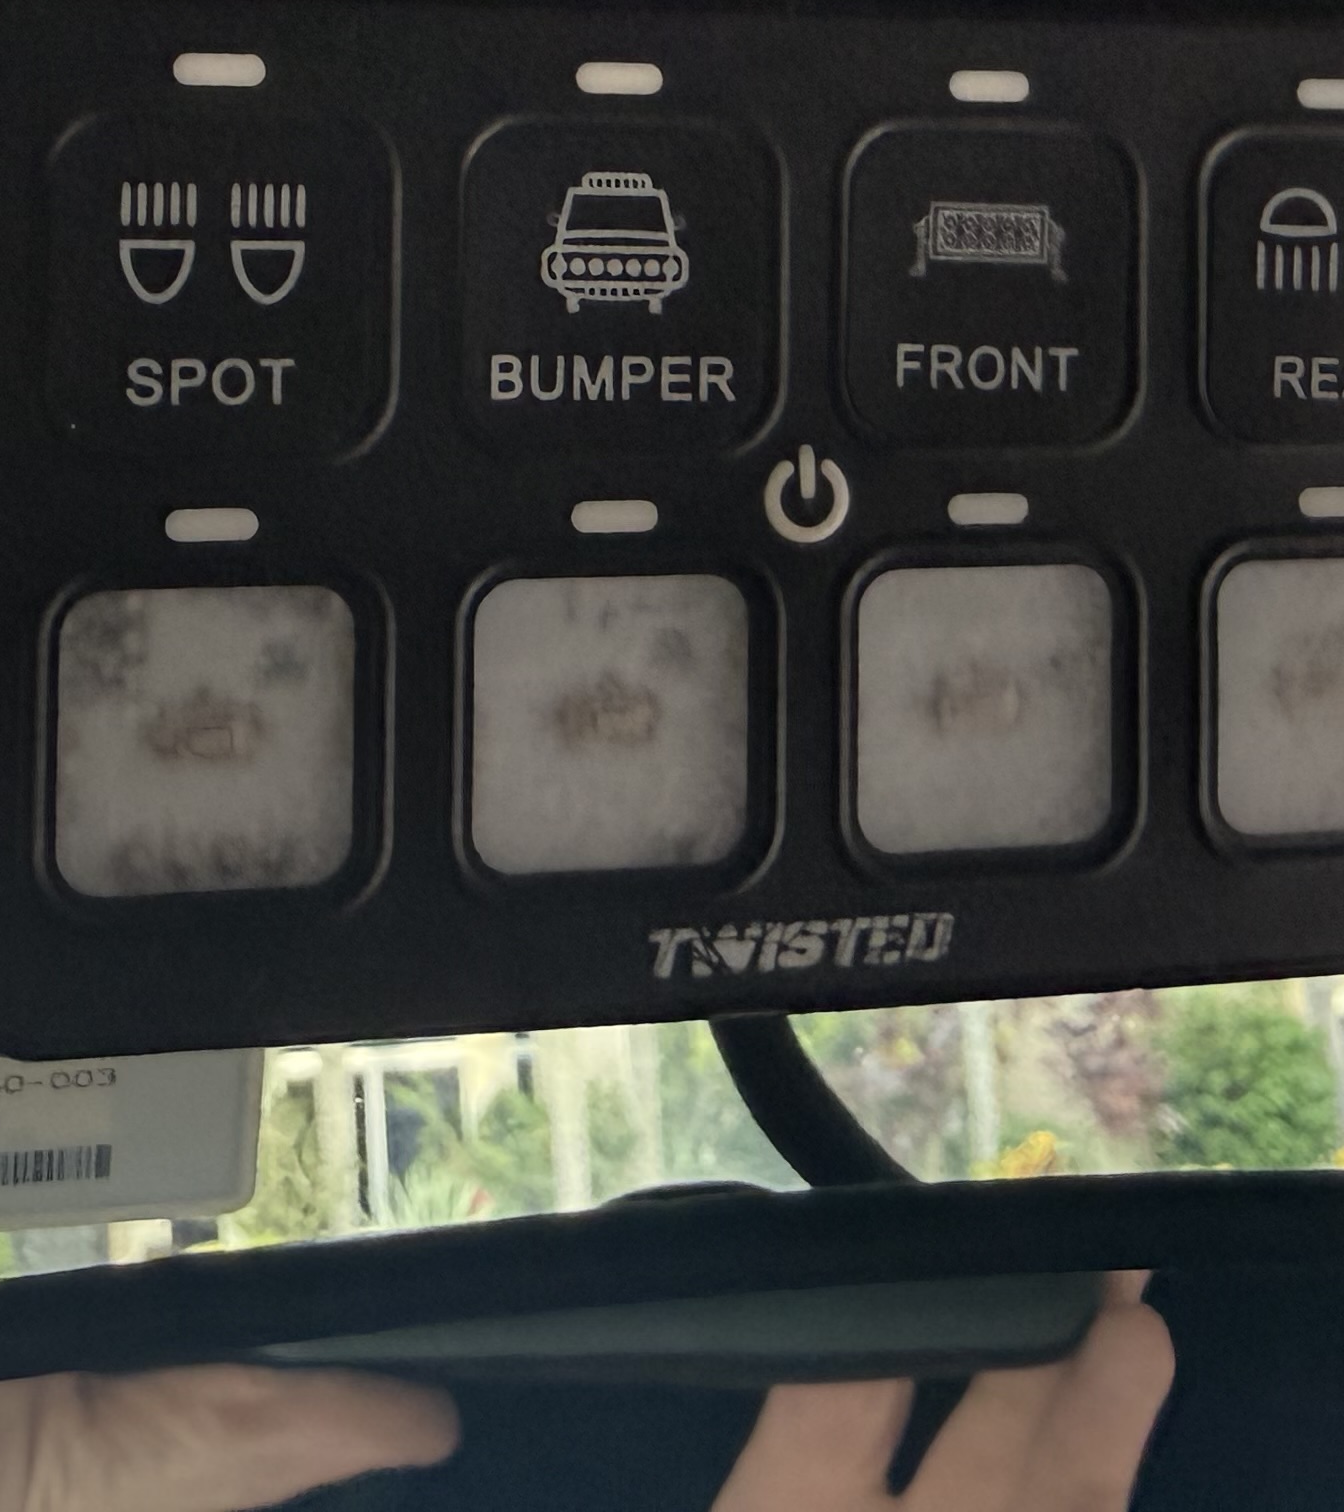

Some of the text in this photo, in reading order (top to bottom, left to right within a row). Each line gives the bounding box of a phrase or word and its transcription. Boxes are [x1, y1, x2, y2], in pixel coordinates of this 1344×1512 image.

[126, 358, 297, 406] SPOT
[489, 353, 738, 402] BUMPER
[895, 343, 1080, 393] FRONT
[648, 912, 955, 979] TWISTED
